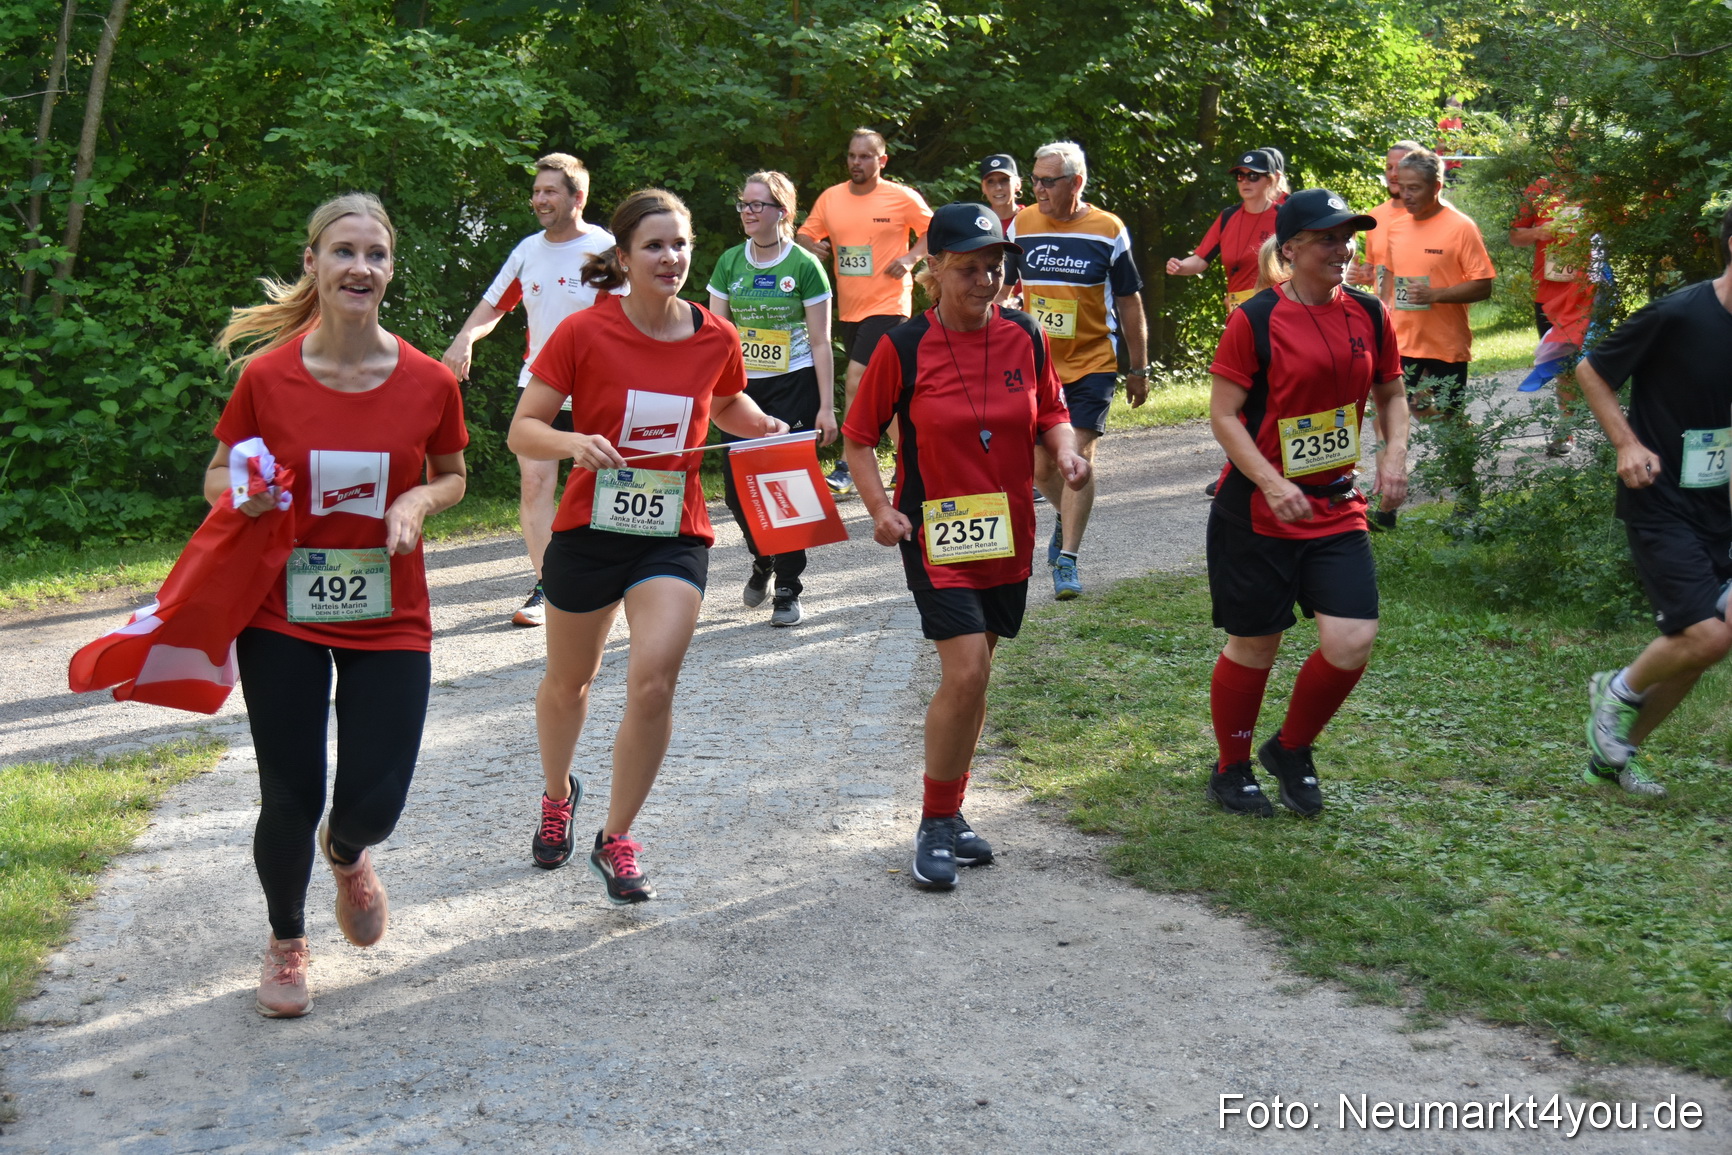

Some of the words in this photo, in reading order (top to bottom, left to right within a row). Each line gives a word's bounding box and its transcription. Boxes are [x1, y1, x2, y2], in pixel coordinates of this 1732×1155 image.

[840, 256, 867, 268] 2433
[1036, 251, 1091, 269] Fischer
[1040, 267, 1086, 275] AUTOMOBILE
[1037, 310, 1064, 328] 743
[741, 342, 782, 361] 2088
[1003, 368, 1024, 387] 24
[642, 428, 665, 437] DEHN
[1291, 428, 1349, 461] 2358
[1305, 457, 1325, 465] Schön
[1325, 452, 1341, 460] Petra
[337, 488, 361, 501] DEHN
[745, 475, 759, 498] DEHN
[613, 491, 665, 518] 505
[773, 490, 791, 510] DEHN
[609, 514, 630, 523] Janka
[631, 517, 665, 526] Eva-Maria
[934, 516, 999, 546] 2357
[941, 544, 973, 553] Schneller
[974, 541, 998, 549] Renate
[308, 575, 368, 602] 492
[311, 602, 339, 610] Härteis
[341, 601, 368, 609] Marina
